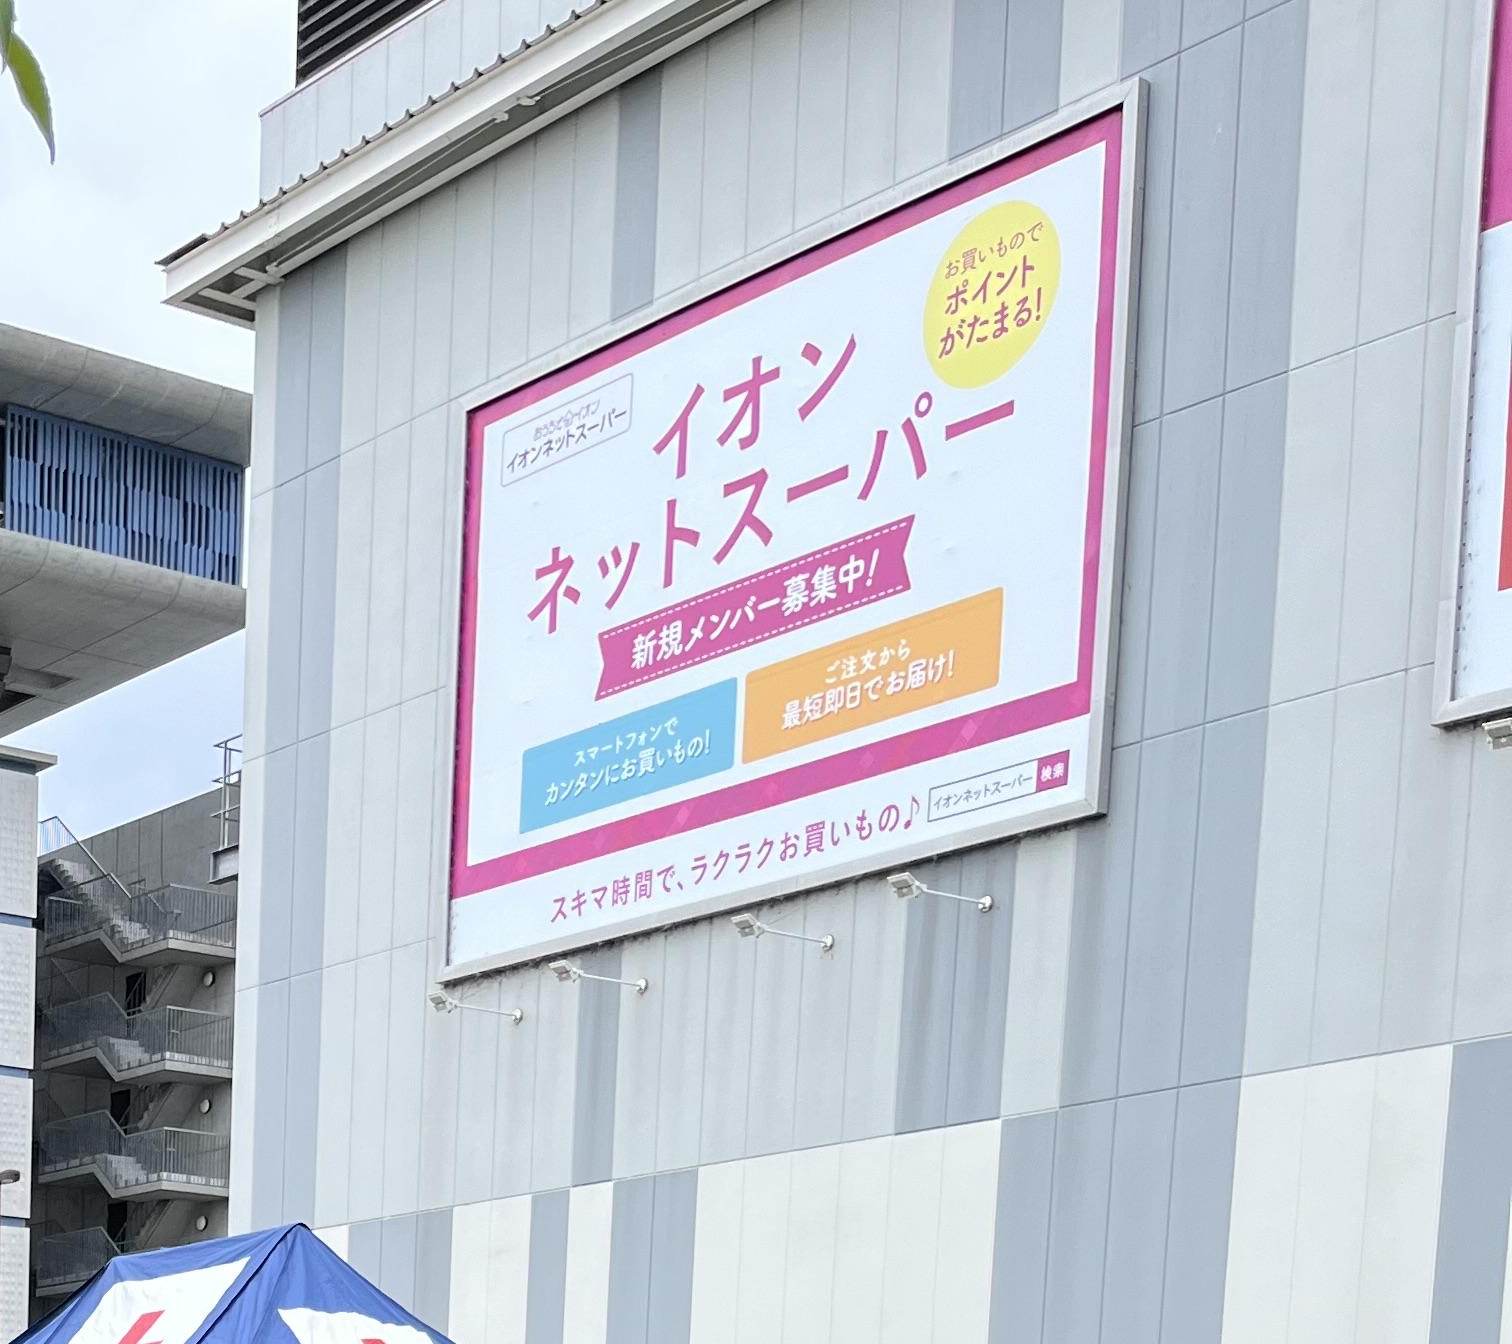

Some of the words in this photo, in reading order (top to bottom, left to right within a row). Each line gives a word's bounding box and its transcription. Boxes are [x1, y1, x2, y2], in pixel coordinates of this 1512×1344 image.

[944, 255, 1035, 315] ポイント
[945, 222, 1043, 279] お買いもので
[938, 287, 1042, 359] がたまる!
[652, 333, 856, 479] イオン
[506, 408, 628, 474] イオンネットスーパー
[526, 391, 1015, 635] ネットスーパー
[630, 548, 880, 670] 新規メンバー募集中!
[780, 649, 955, 730] 最短即日でお届け!
[824, 639, 911, 684] ご注文から
[544, 728, 711, 806] カンタンにお買いもの!
[574, 716, 679, 768] スマートフォンで
[933, 774, 1033, 811] イオンネットスーパー
[1040, 762, 1066, 782] 検索
